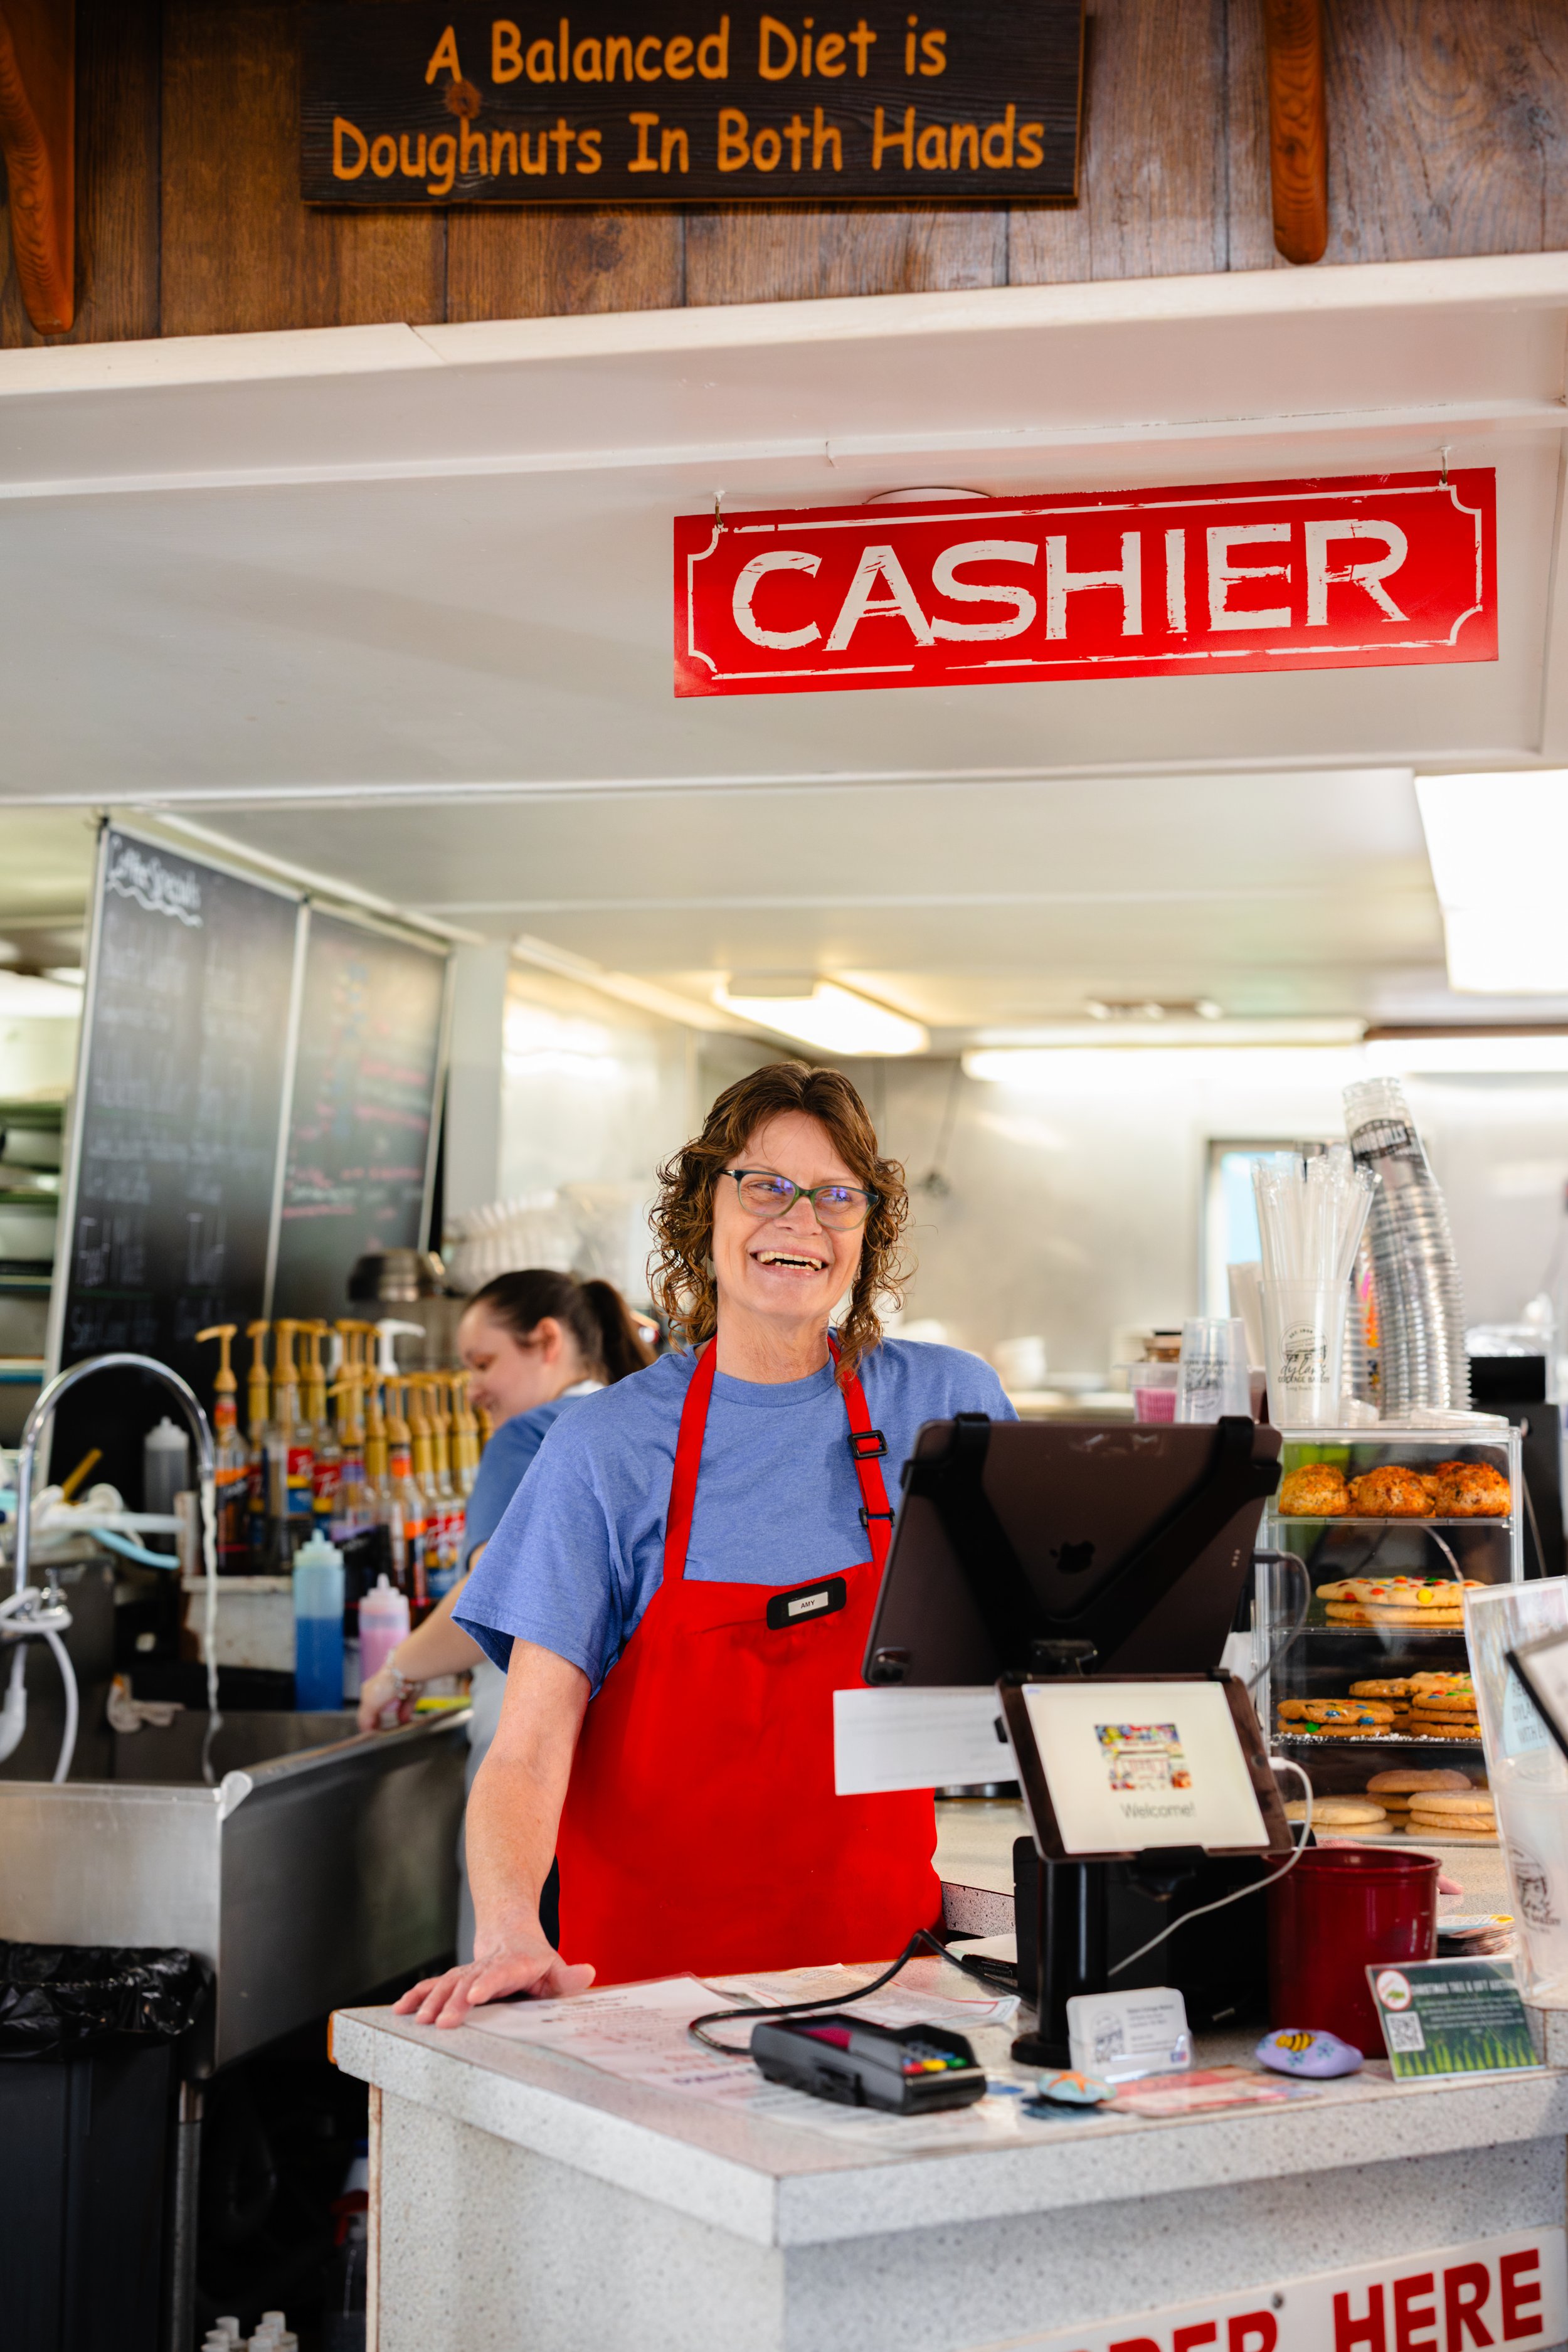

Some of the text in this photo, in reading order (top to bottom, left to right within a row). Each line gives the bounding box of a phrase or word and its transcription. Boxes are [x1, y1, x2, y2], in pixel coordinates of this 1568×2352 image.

[426, 15, 946, 84] A Balanced Diet is
[333, 104, 1043, 195] Doughnuts In Both Hands
[731, 518, 1411, 652] CASHIER
[801, 1600, 815, 1608] AMY
[1120, 1801, 1196, 1819] Welcome!
[1333, 2249, 1543, 2352] HERE
